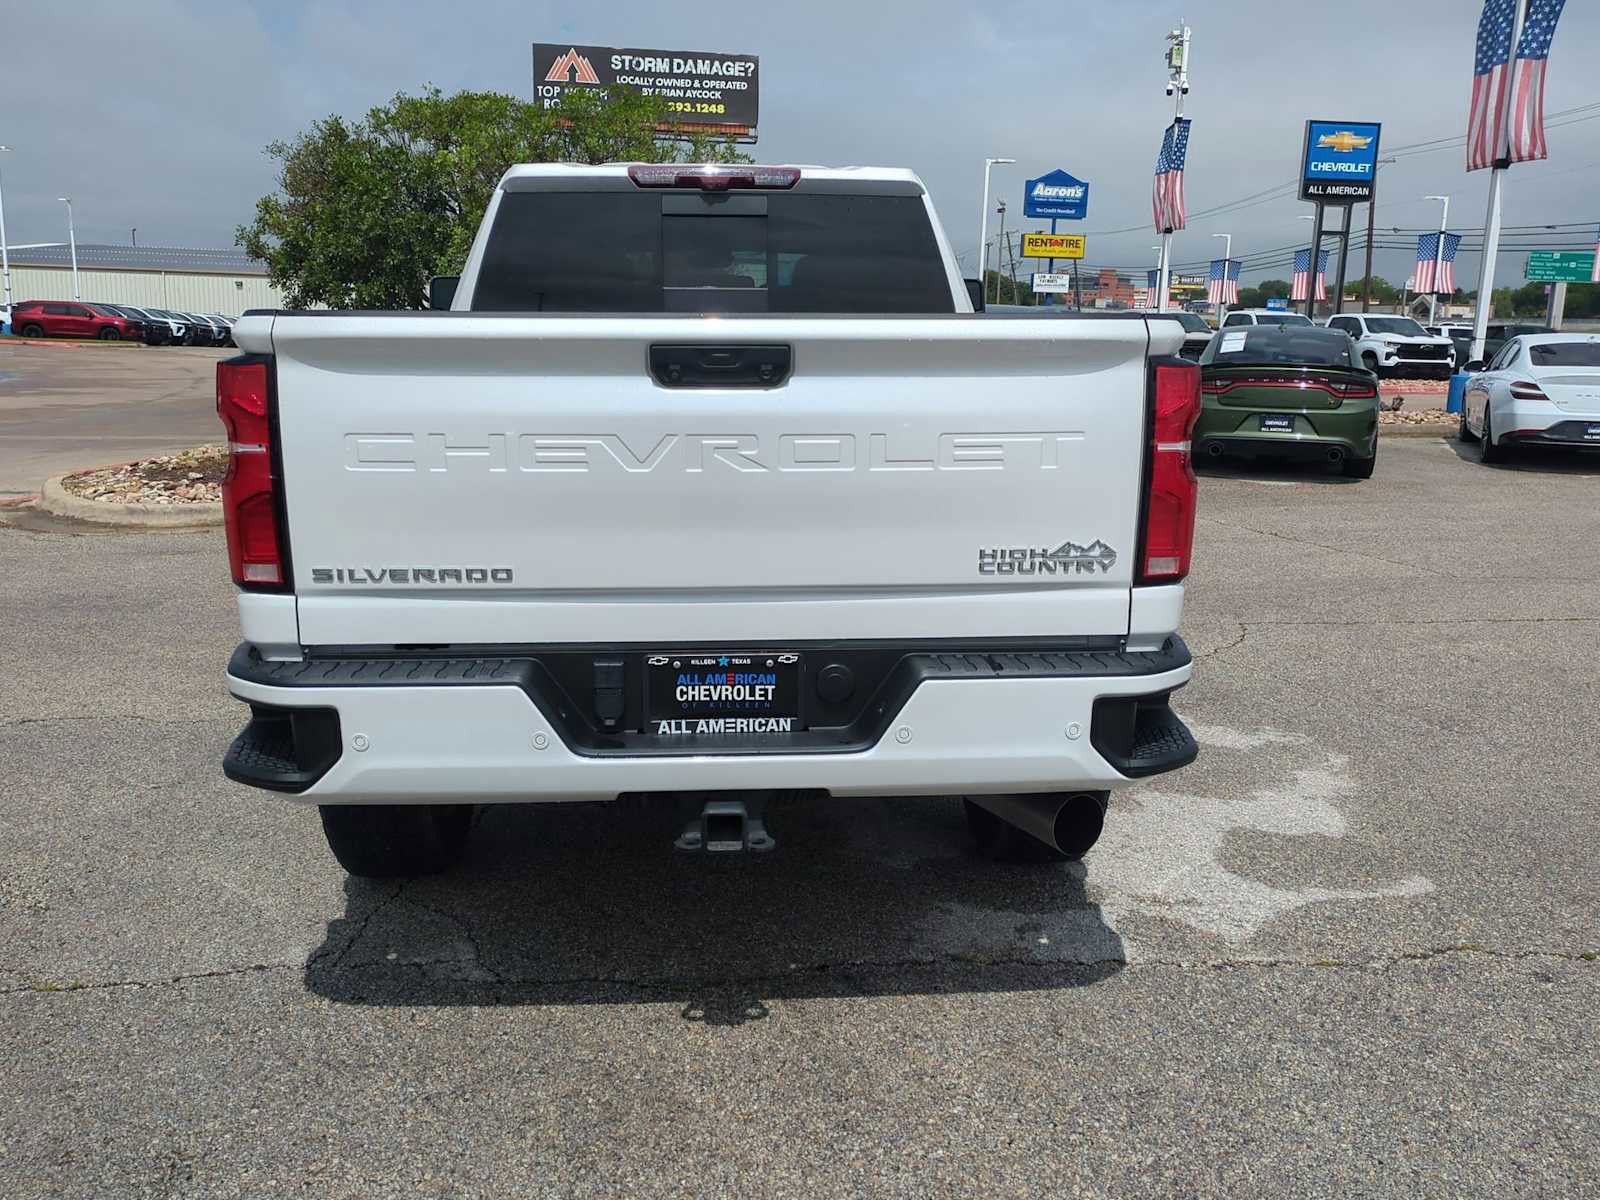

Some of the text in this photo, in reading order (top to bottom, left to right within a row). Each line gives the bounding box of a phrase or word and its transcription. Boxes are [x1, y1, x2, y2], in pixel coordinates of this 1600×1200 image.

[611, 54, 756, 78] STORM DAMAGE?
[616, 75, 748, 90] LOCALLY OWNED & OPERATED
[537, 85, 561, 97] TOP
[642, 88, 653, 96] BY
[685, 90, 722, 99] AYCOCK
[1311, 161, 1372, 173] CHEVROLET
[1031, 182, 1086, 198] Aaron's
[1308, 185, 1370, 196] ALL AMERICAN
[343, 431, 1086, 473] CHEVROLET
[979, 549, 1049, 560] HIGH
[979, 559, 1117, 575] COUNTRY
[311, 567, 514, 584] SILVERADO
[690, 658, 716, 666] KILLEEN
[677, 672, 776, 685] ALL AMERICAN
[675, 684, 776, 702] CHEVROLET
[657, 717, 791, 736] ALL AMERICAN
